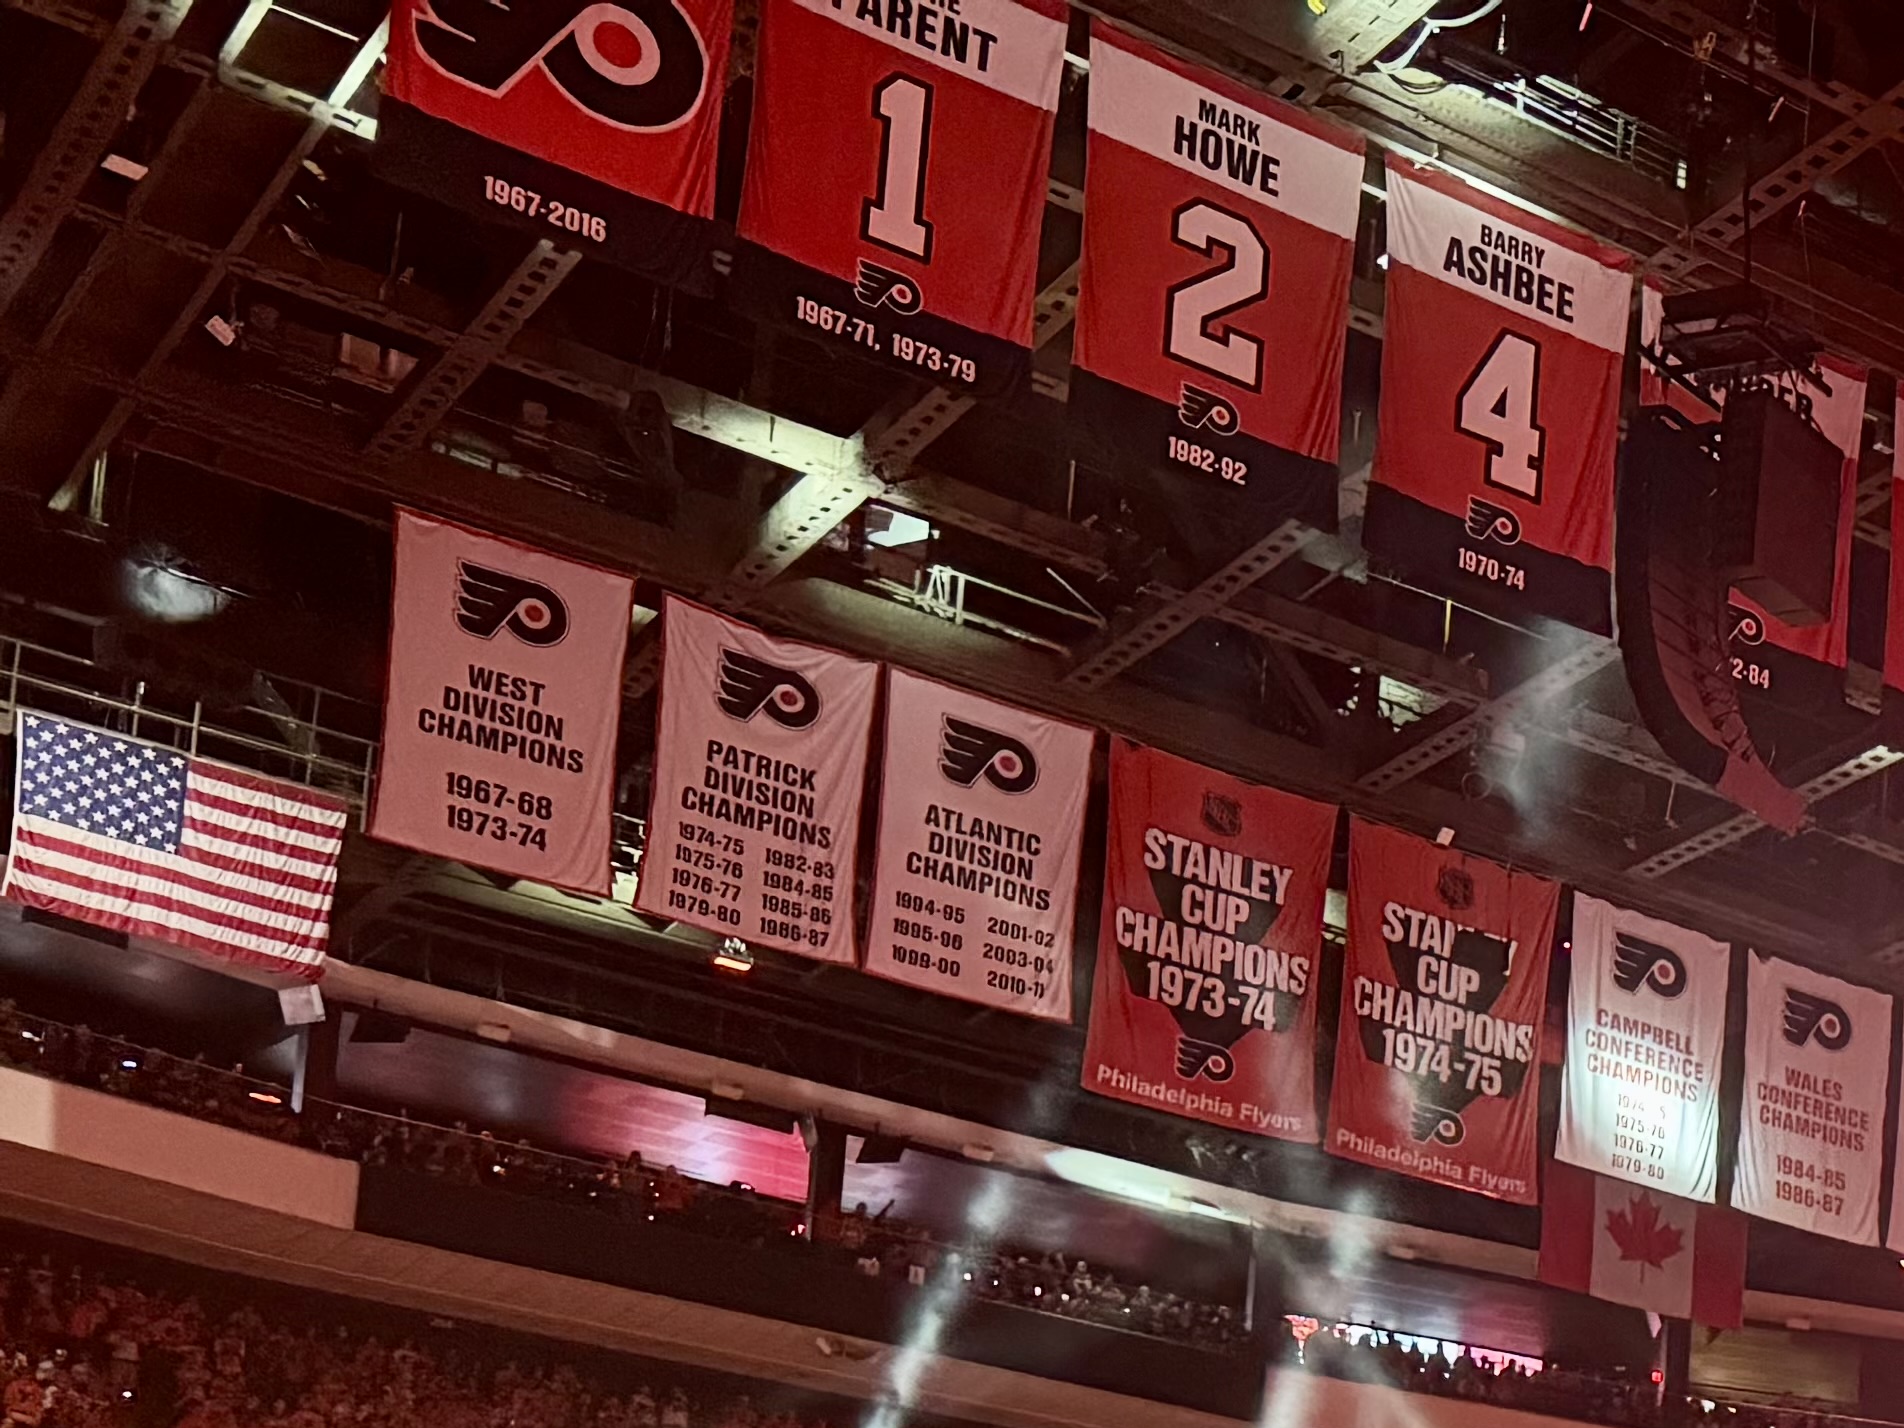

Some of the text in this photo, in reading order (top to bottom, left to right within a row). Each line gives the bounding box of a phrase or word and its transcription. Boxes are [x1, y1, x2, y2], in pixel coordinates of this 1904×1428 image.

[1198, 97, 1262, 146] MARK
[860, 72, 934, 264] 1
[1174, 116, 1280, 197] HOWE
[484, 175, 607, 243] 1967-2016
[1481, 223, 1546, 270] BARRY
[1163, 197, 1271, 393] 2
[1444, 237, 1575, 324] ASHBEE
[891, 330, 977, 384] 1973-79
[1456, 328, 1546, 503] 4
[1168, 434, 1248, 485] 1982-92
[1458, 546, 1526, 591] 1970-74
[468, 664, 546, 706] WEST
[443, 686, 564, 741] DIVISION
[418, 708, 584, 774] CHAMPIONS
[706, 740, 817, 792] PATRICK
[445, 771, 553, 821] 1967-68
[704, 765, 815, 818] DIVISION
[447, 804, 548, 853] 1973-74
[678, 821, 745, 856] 1974-75
[682, 786, 832, 850] CHAMPIONS
[925, 804, 1041, 856] ATLANTIC
[675, 844, 743, 879] 1975-76
[765, 848, 835, 880] 1982-83
[906, 851, 1051, 911] CHAMPIONS
[928, 832, 1034, 880] DIVISION
[1143, 827, 1294, 906] STANLEY
[668, 890, 741, 926] 1979-80
[672, 867, 741, 902] 1976-77
[762, 893, 832, 925] 1985-86
[763, 871, 833, 902] 1984-85
[896, 890, 965, 924] 1994-95
[760, 917, 830, 947] 1986-87
[987, 917, 1055, 948] 2001-02
[1180, 890, 1250, 934] CUP
[982, 942, 1054, 974] 2003-04
[1115, 906, 1311, 995] CHAMPIONS
[1146, 960, 1278, 1032] 1973-74
[1416, 955, 1481, 1002] CUP
[1354, 975, 1534, 1064] CHAMPIONS
[1596, 1008, 1695, 1056] CAMPBELL
[1381, 1027, 1502, 1097] 1974-75
[1585, 1028, 1704, 1082] CONFERENCE
[1587, 1053, 1698, 1103] CHAMPIONS
[1096, 1063, 1304, 1133] Philadelphia Flyers
[1757, 1082, 1870, 1132] CONFERENCE
[1785, 1066, 1842, 1101] WALES
[1759, 1103, 1865, 1153] CHAMPIONS
[1335, 1127, 1528, 1196] Philadelphia Flyers
[1775, 1154, 1846, 1192] 1984-85
[1774, 1181, 1845, 1217] 1986-87
